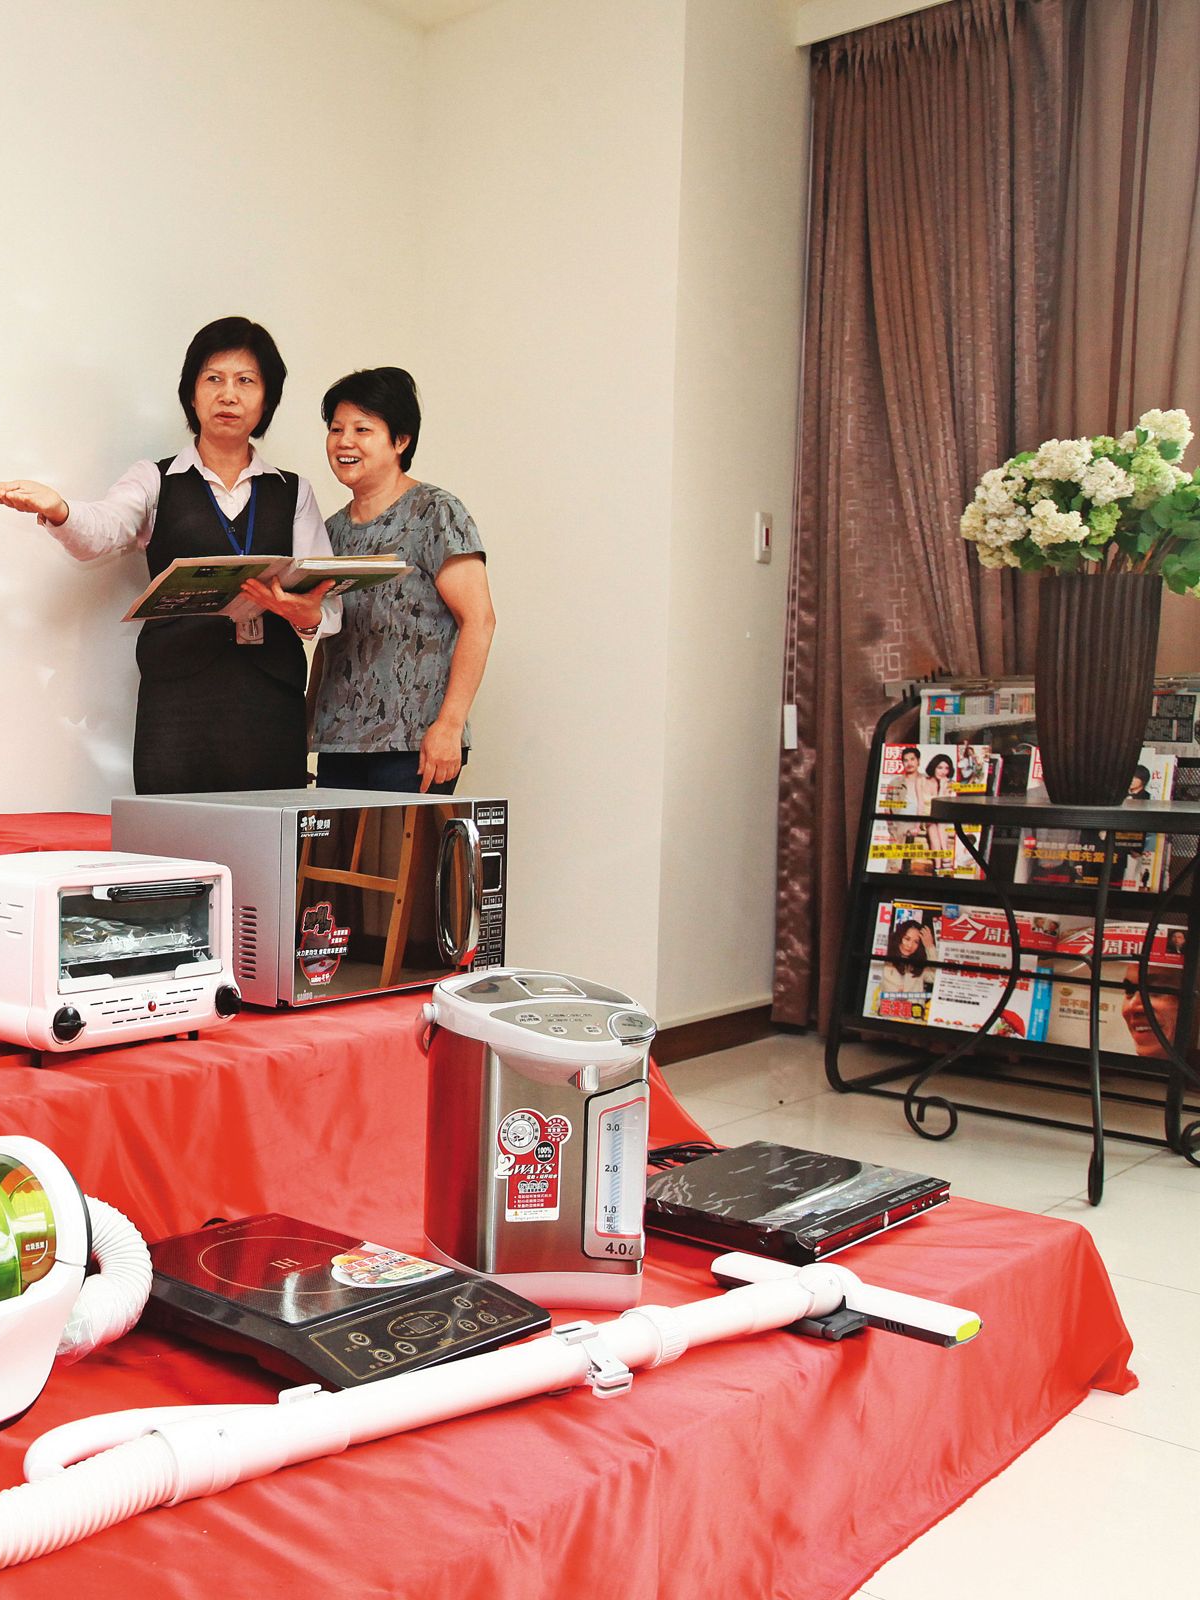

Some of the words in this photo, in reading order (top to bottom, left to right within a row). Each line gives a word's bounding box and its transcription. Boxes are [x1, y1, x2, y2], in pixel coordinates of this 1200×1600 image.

[606, 1123, 620, 1132] 3.0
[604, 1164, 618, 1173] 2.0
[603, 1205, 617, 1214] 1.0
